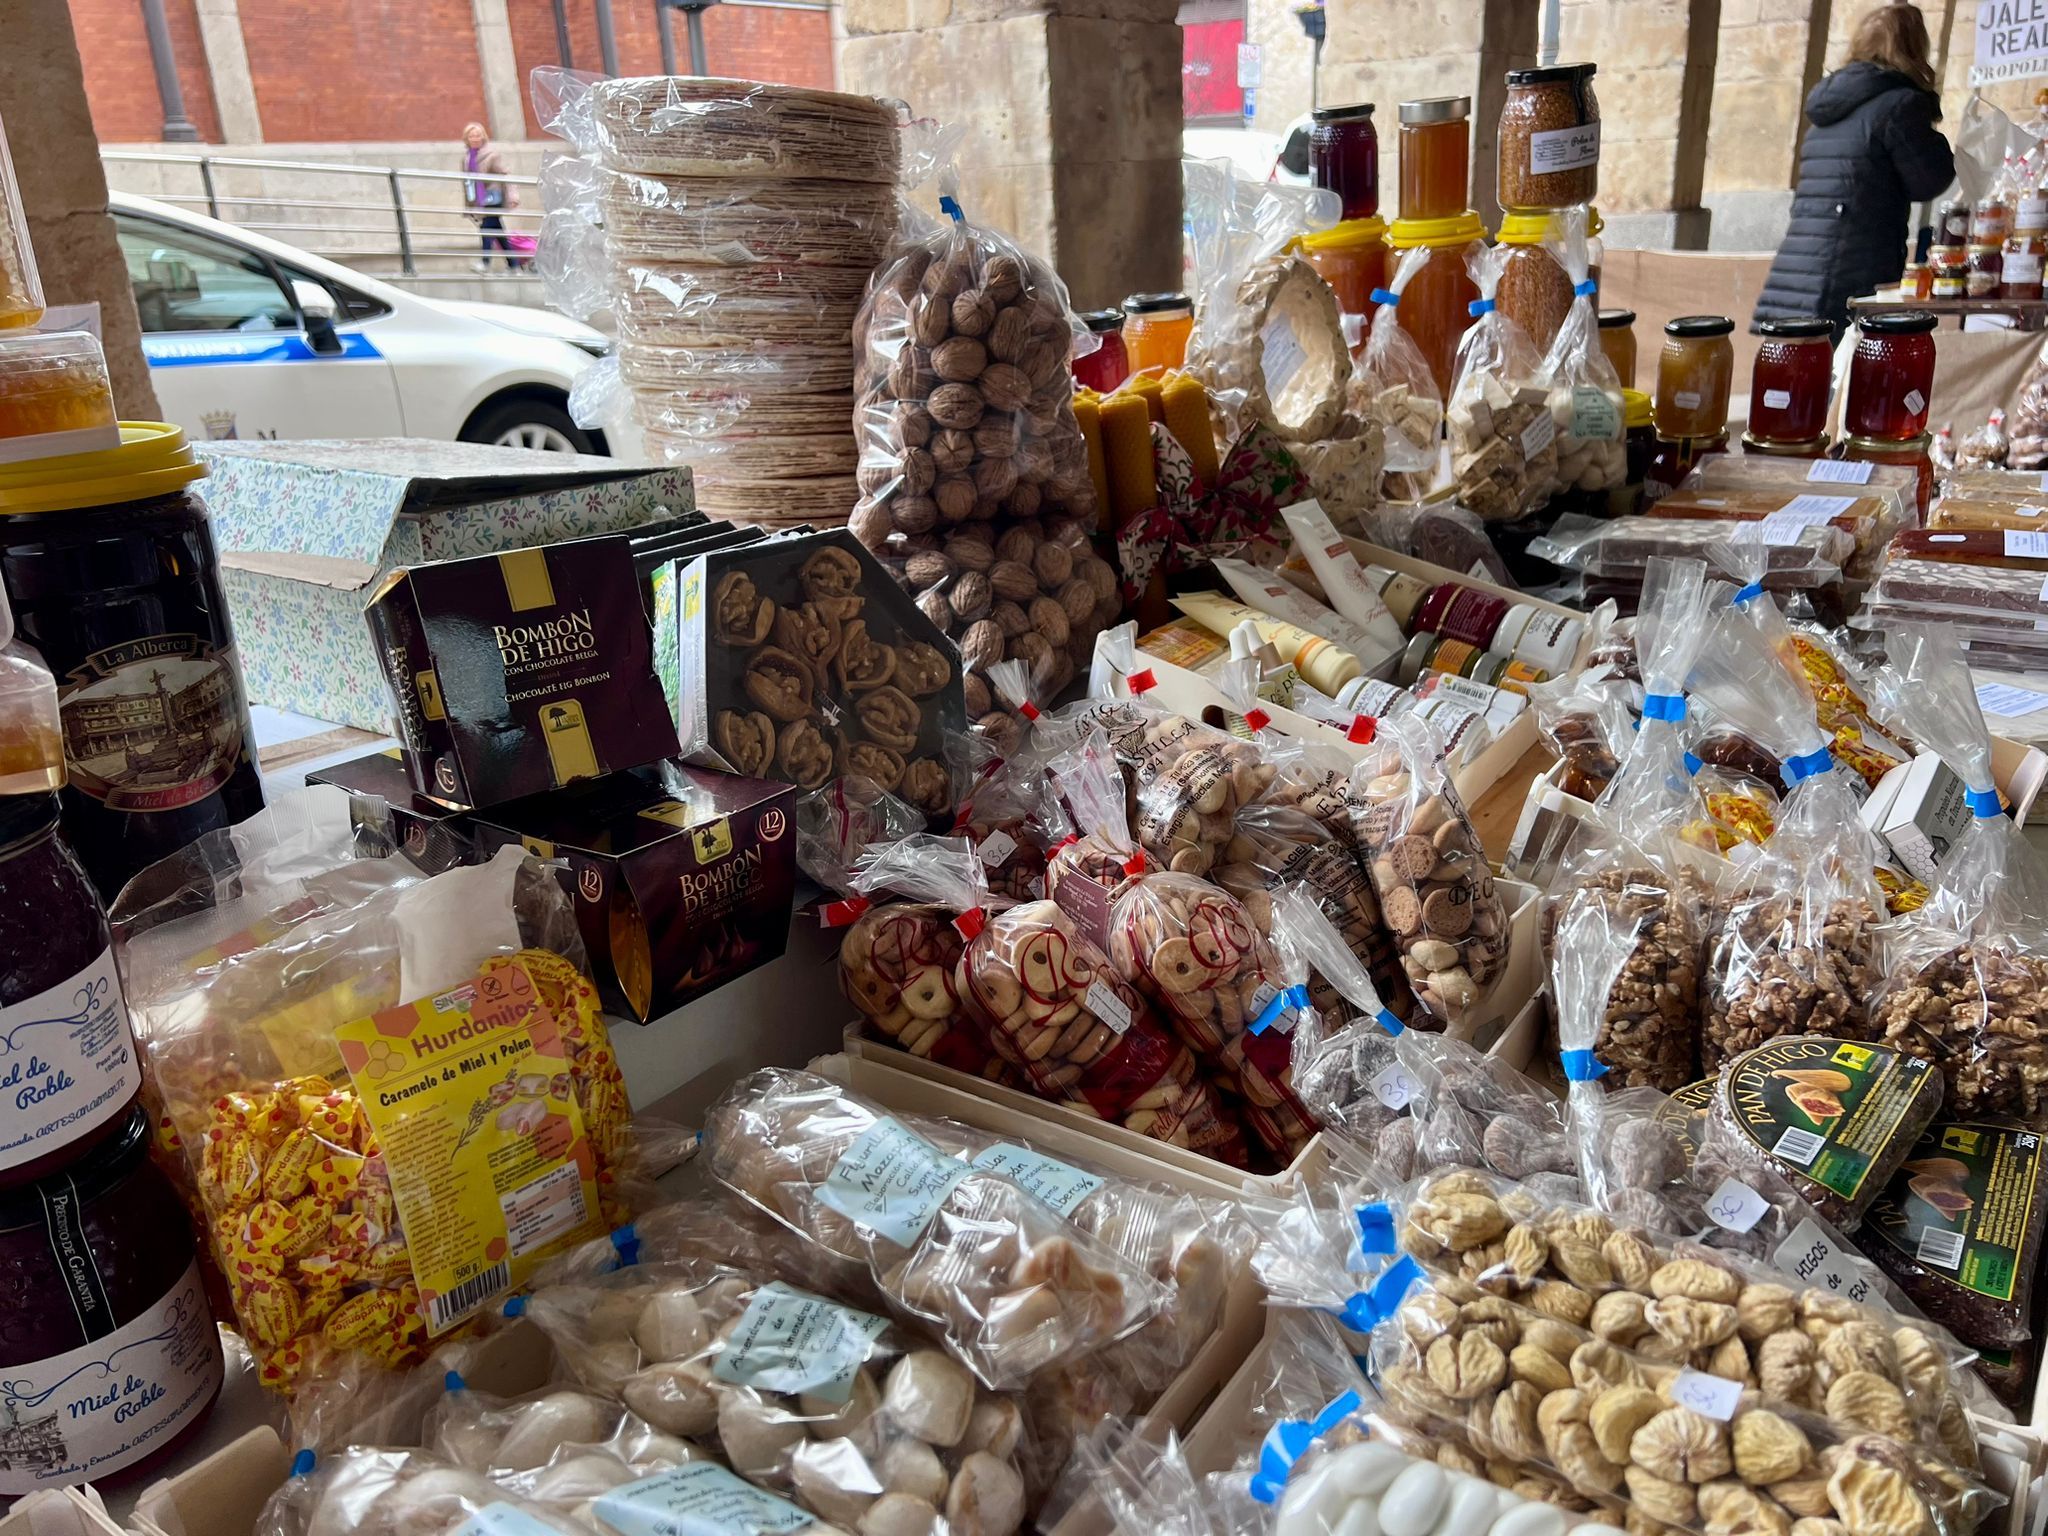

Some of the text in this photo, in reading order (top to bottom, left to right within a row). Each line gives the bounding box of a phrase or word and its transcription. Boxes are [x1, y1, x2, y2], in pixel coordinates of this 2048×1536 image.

[492, 608, 593, 649] BOMBÓN
[103, 638, 188, 667] La Alberca
[501, 631, 595, 667] DE HIGO
[504, 665, 524, 676] CON
[525, 655, 574, 672] CHOCOLATE
[575, 650, 599, 661] BELGA
[504, 684, 558, 704] CHOCOLATE
[1122, 720, 1197, 776] ASTILLA
[765, 810, 780, 831] 12
[583, 869, 598, 891] 12
[411, 999, 540, 1058] Hurdanitos
[0, 1056, 51, 1089] iel de
[16, 1069, 75, 1111] Roble
[380, 1075, 438, 1107] Caramelo
[442, 1067, 456, 1083] de
[460, 1054, 487, 1075] Miel
[489, 1052, 499, 1066] y
[499, 1038, 532, 1057] Polen
[1736, 1042, 1828, 1125] PAN DE HIGO
[455, 1264, 472, 1281] 500
[1794, 1241, 1829, 1281] HIGOS
[1826, 1273, 1843, 1290] de
[782, 1300, 814, 1349] lmendras
[67, 1373, 146, 1420] Miel de
[113, 1384, 168, 1424] Roble
[81, 1461, 90, 1474] y
